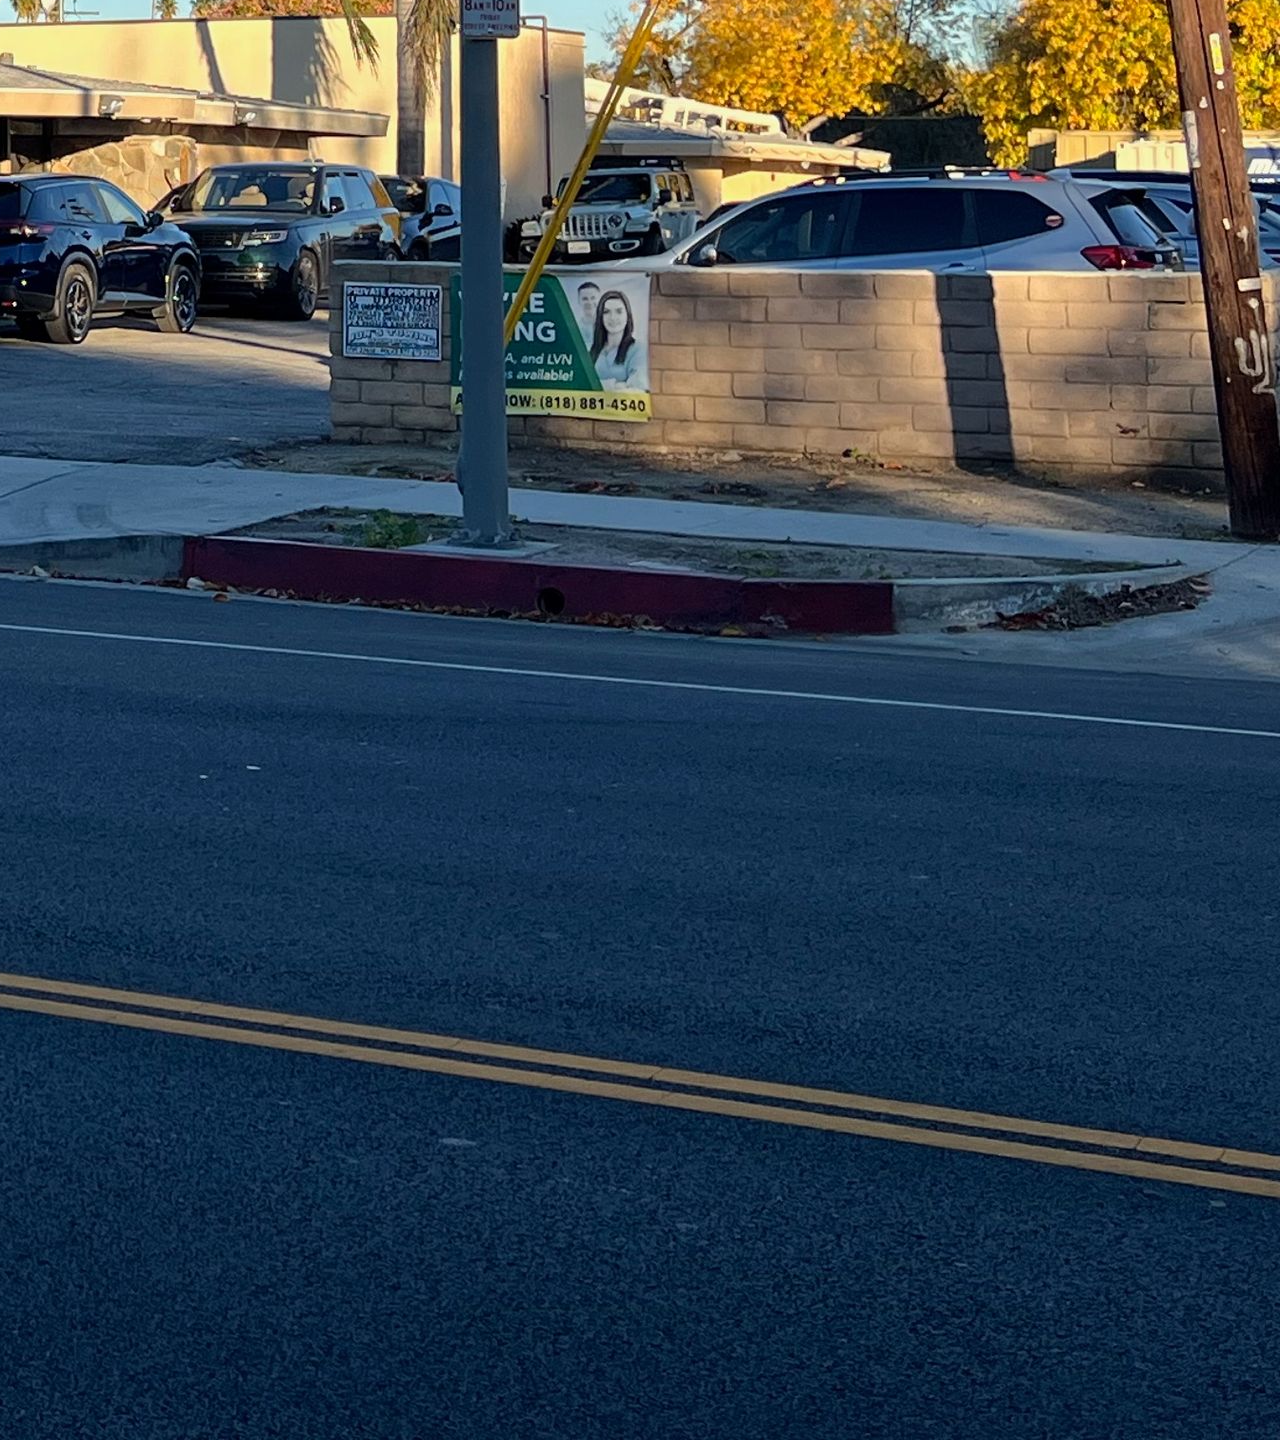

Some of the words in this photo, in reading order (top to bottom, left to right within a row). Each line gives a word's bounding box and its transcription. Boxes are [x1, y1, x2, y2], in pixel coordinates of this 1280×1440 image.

[347, 286, 386, 296] PRIVATE
[388, 288, 439, 298] PROPERTY
[521, 352, 545, 365] and
[547, 353, 573, 366] LVN
[516, 368, 575, 382] available!
[540, 395, 577, 411] (818)
[580, 397, 647, 413] 881-4540
